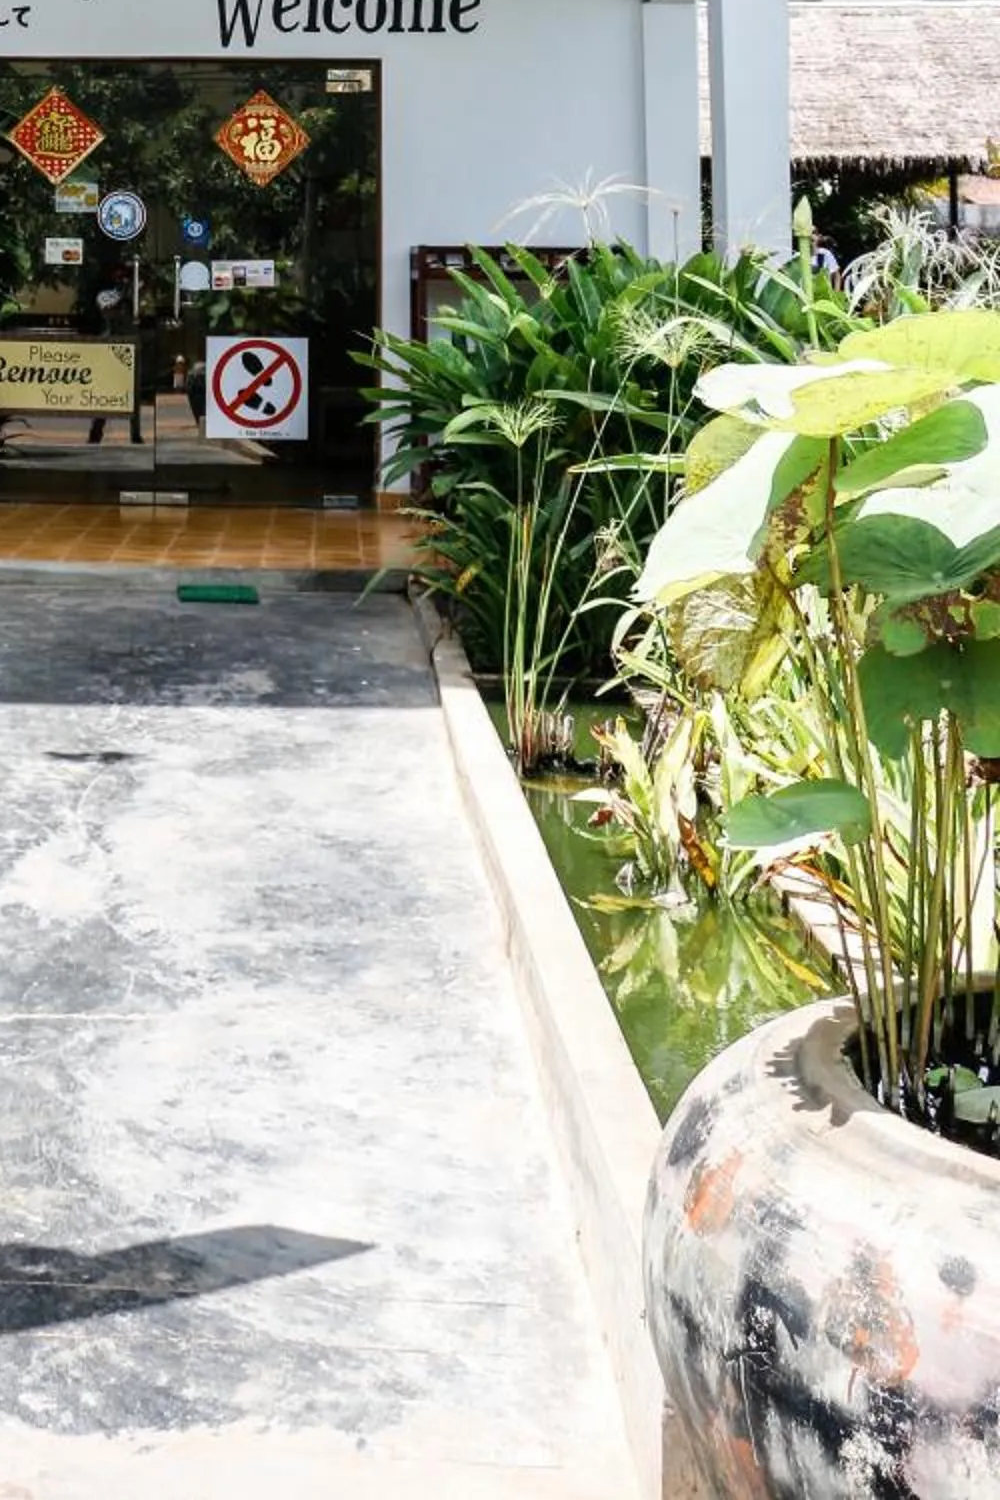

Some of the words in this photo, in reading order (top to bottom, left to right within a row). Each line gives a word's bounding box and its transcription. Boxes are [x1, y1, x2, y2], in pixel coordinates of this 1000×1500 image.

[240, 117, 283, 161] 福
[29, 345, 81, 363] Please
[42, 389, 74, 406] Your
